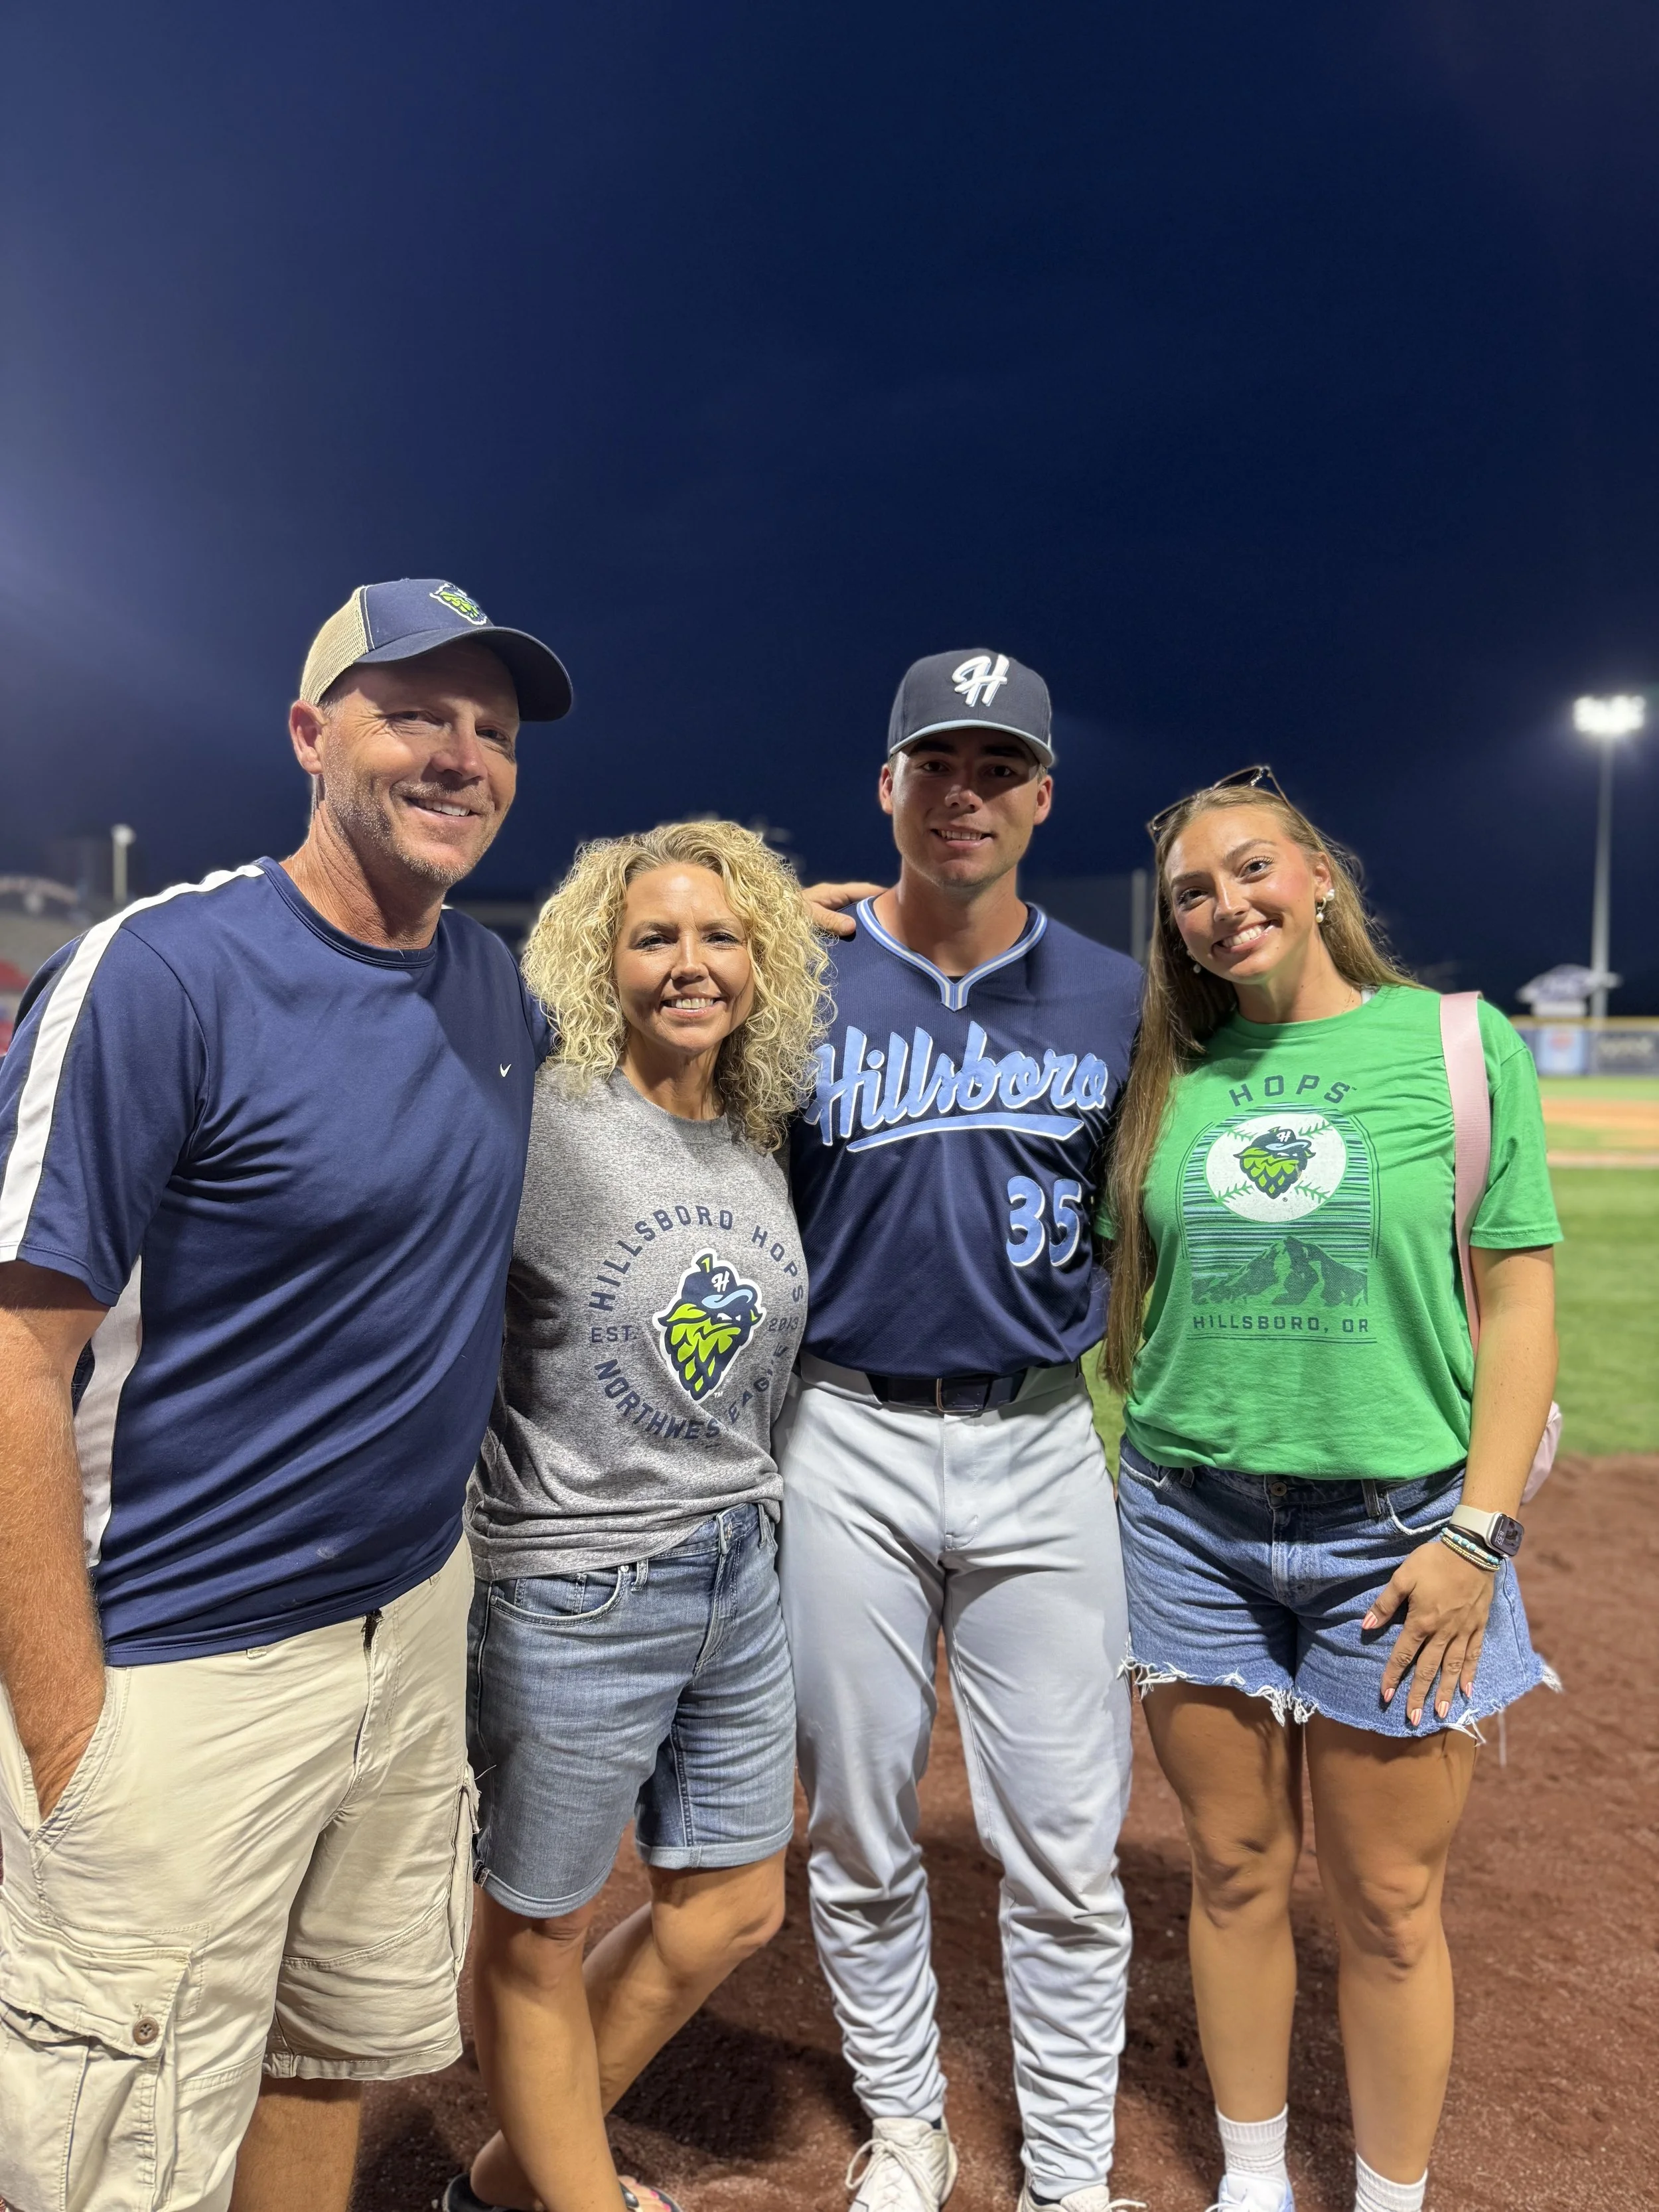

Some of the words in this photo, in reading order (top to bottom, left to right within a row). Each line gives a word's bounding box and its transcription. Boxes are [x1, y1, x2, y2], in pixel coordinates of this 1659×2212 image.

[952, 654, 1010, 707] H
[804, 1021, 1108, 1146] Hillsboro
[1229, 1074, 1350, 1107] HOPS
[1006, 1176, 1082, 1268] 35
[589, 1205, 733, 1311] HILLSBORO
[751, 1225, 804, 1303] HOPS
[591, 1325, 637, 1343] EST.
[1193, 1315, 1329, 1333] HILLSBORO,
[1342, 1319, 1368, 1333] OR
[595, 1359, 723, 1439] NORTHWES
